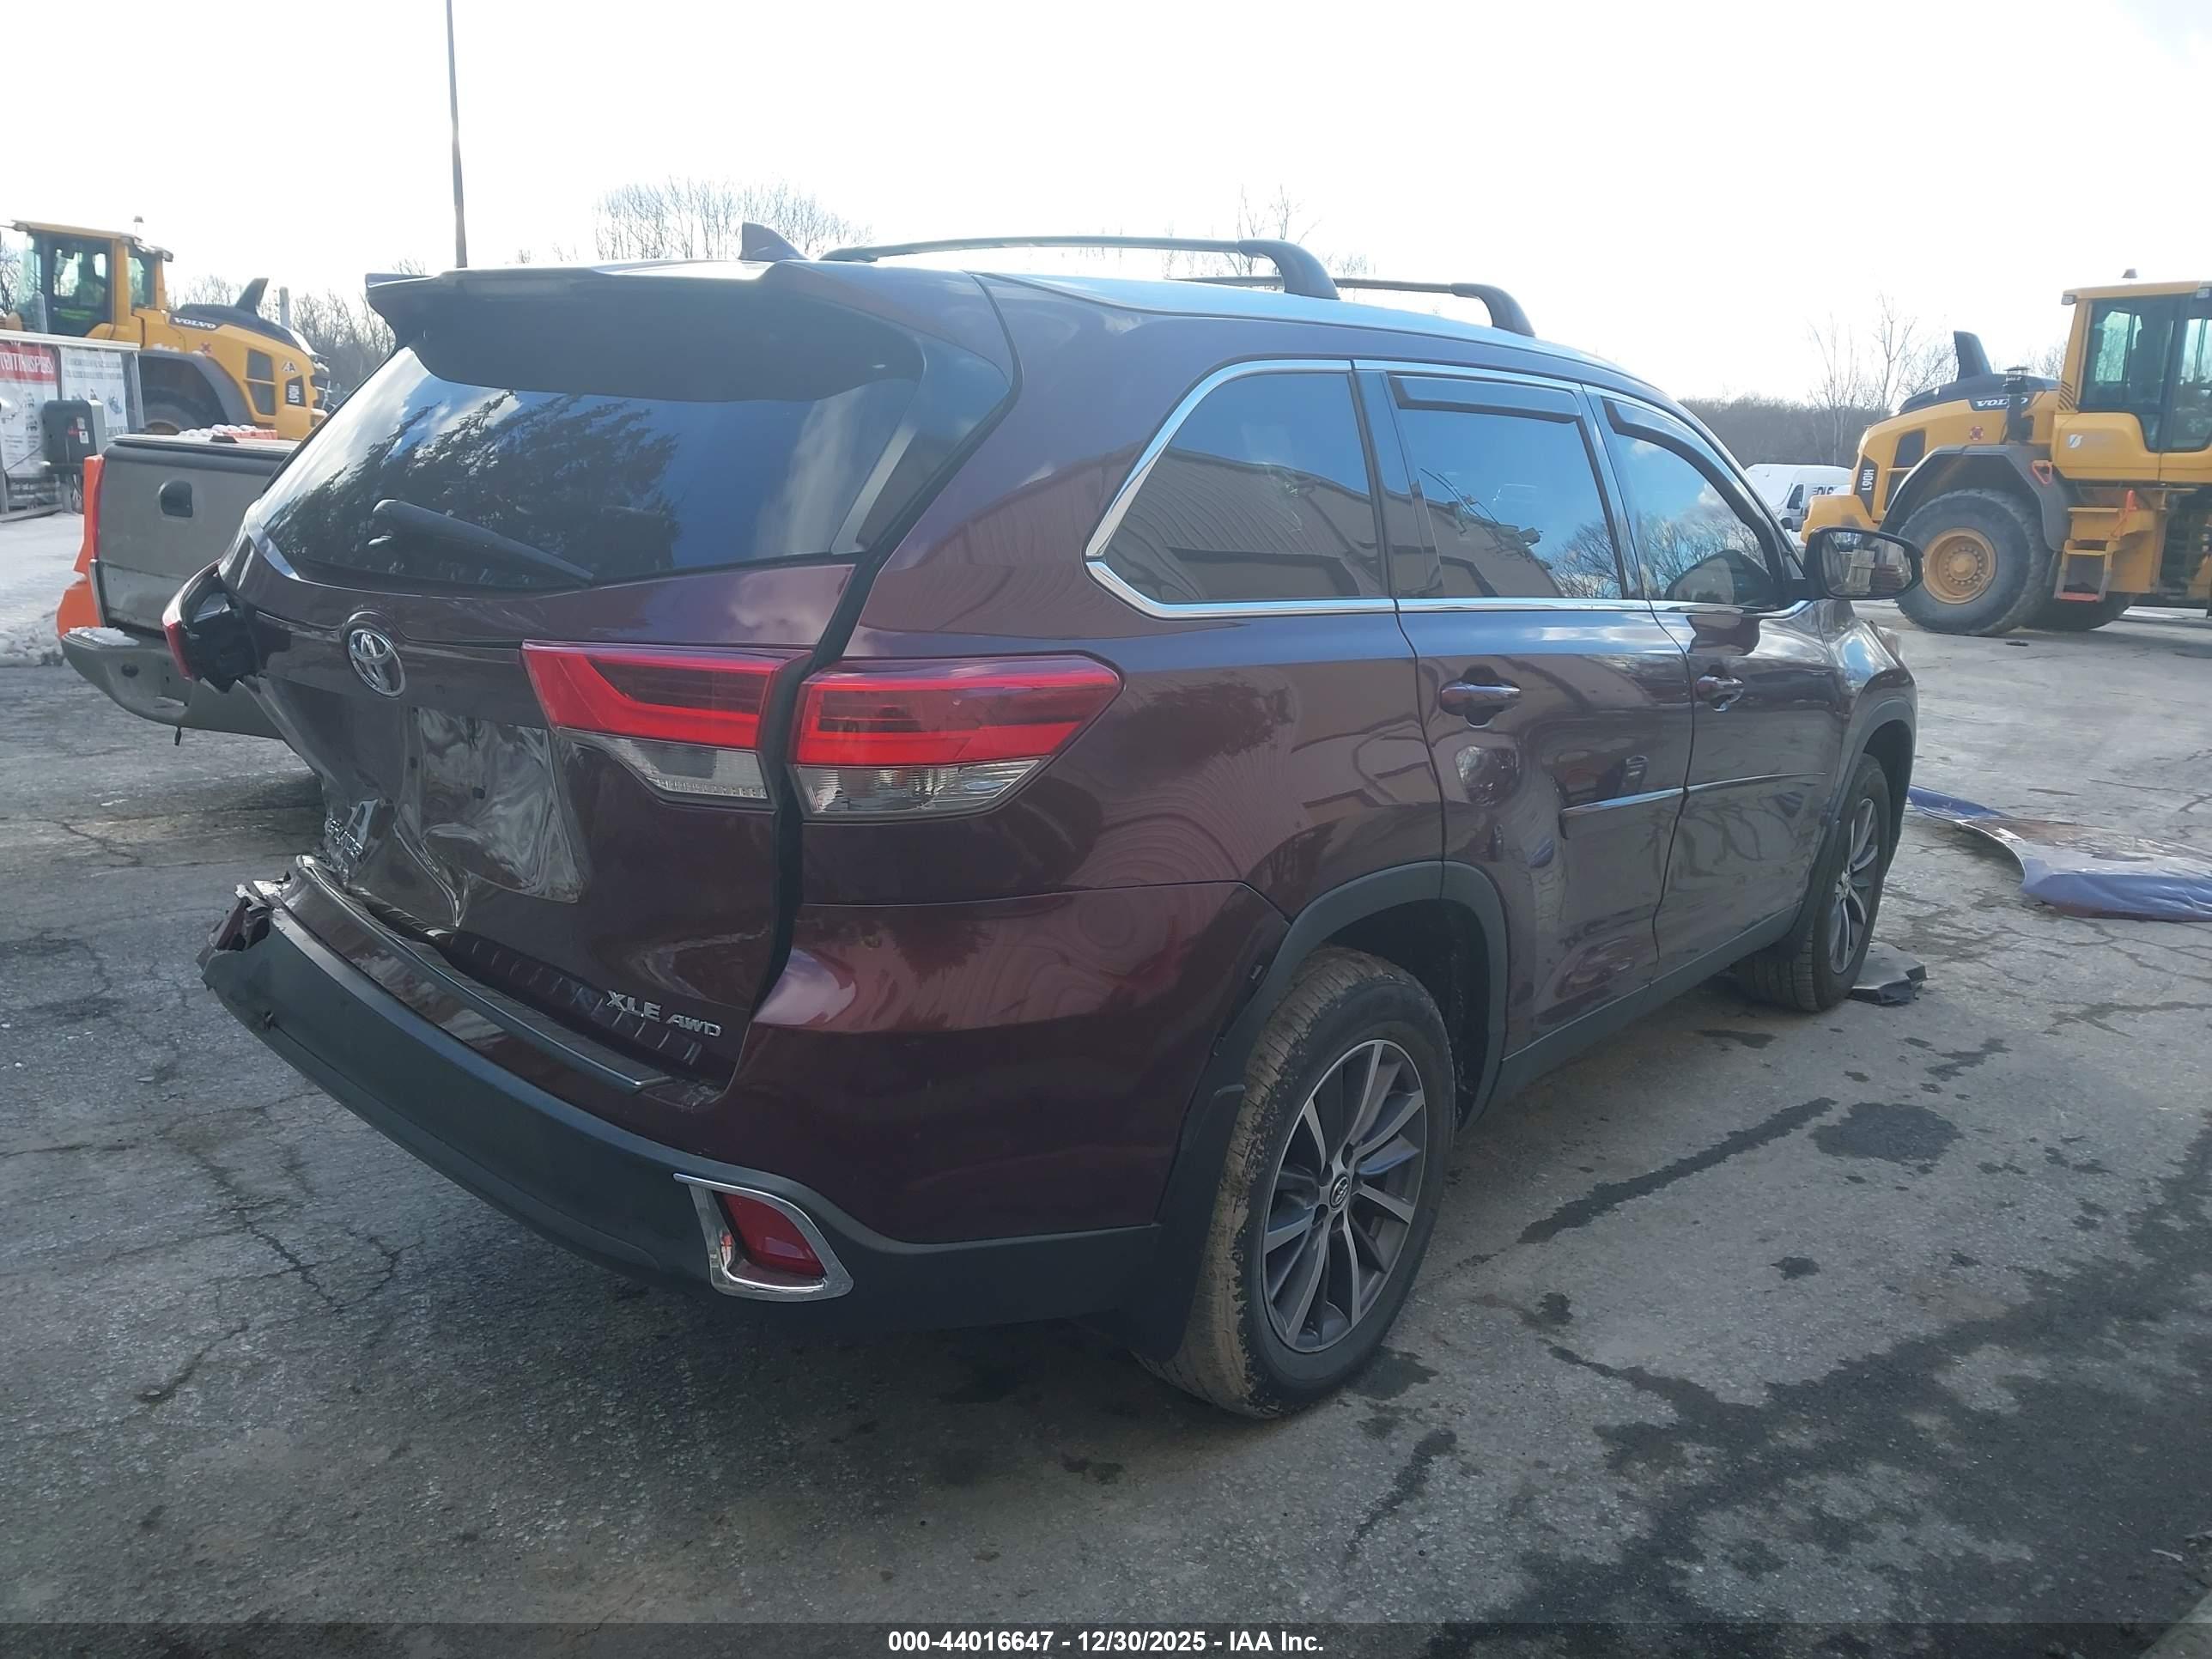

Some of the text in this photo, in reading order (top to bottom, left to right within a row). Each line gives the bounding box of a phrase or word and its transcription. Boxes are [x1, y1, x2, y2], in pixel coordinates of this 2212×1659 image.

[174, 317, 216, 329] VOLVO
[1976, 397, 2028, 407] VOLO
[1861, 469, 1875, 491] L90H
[606, 990, 721, 1037] XLE AWD
